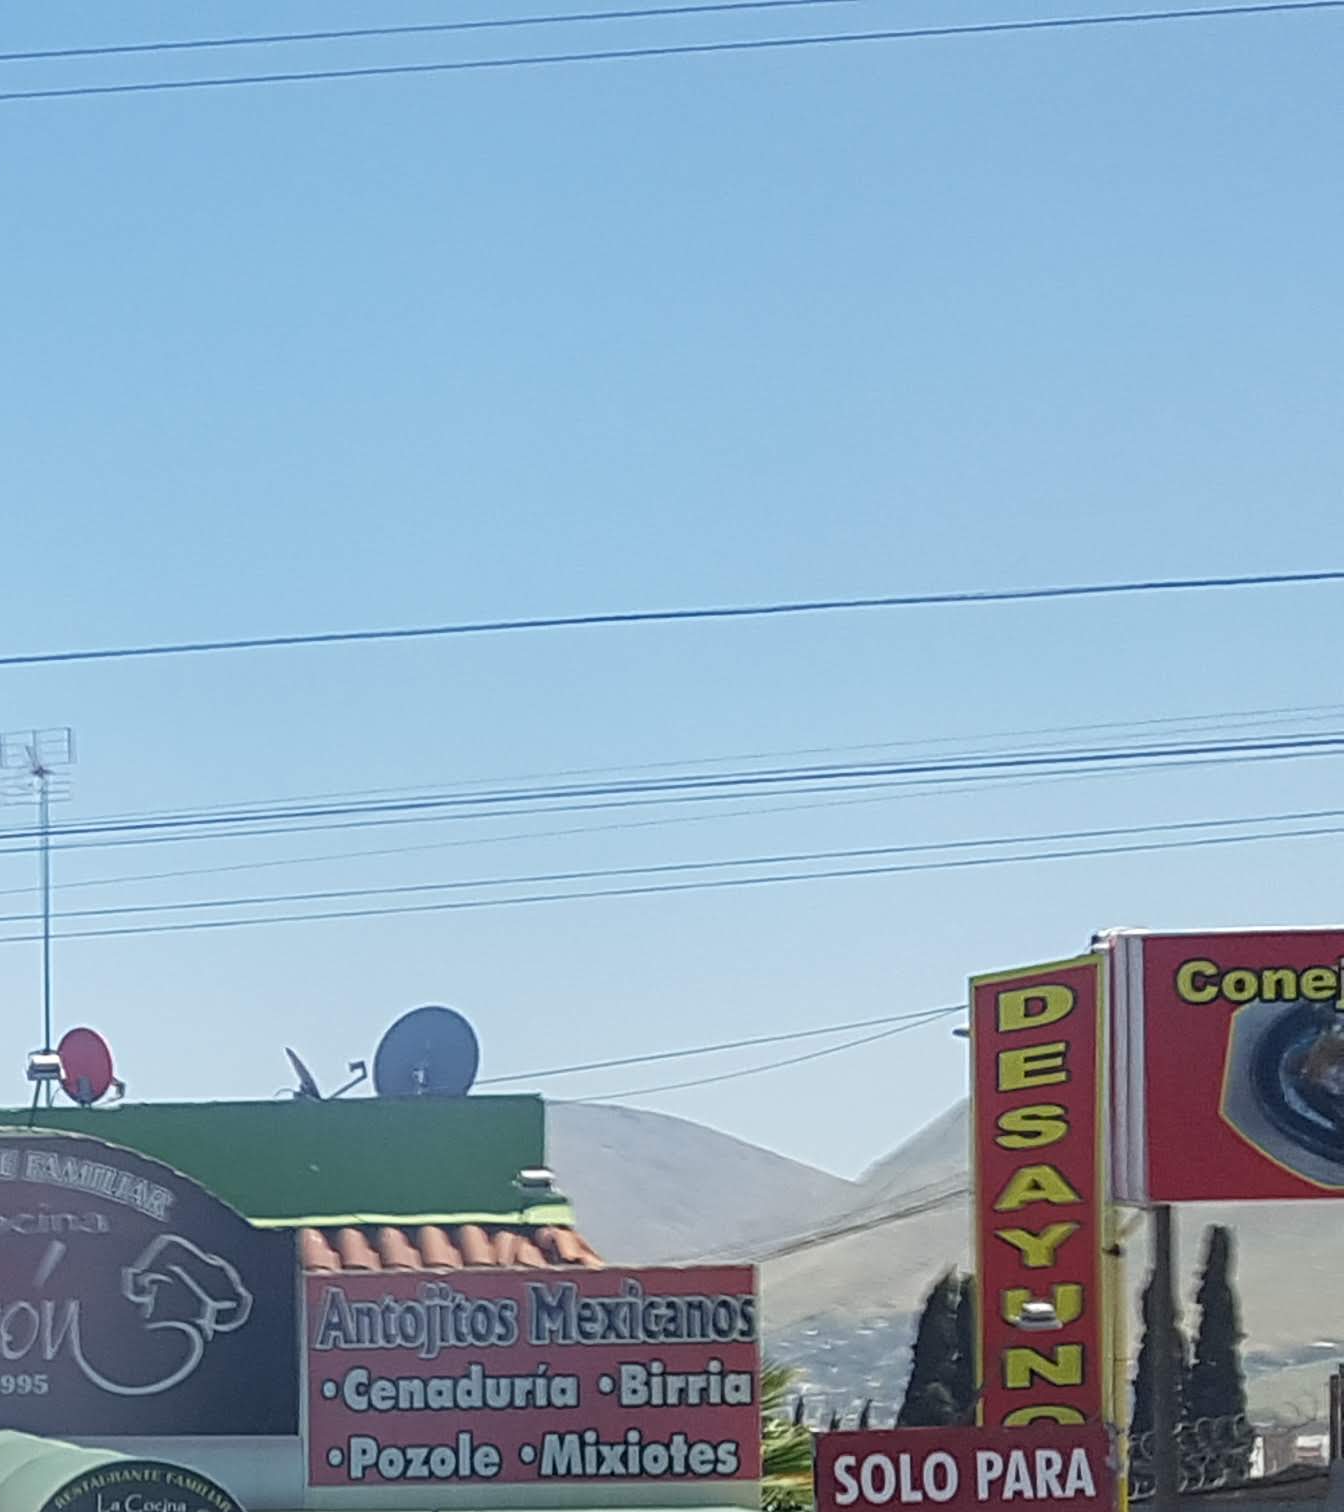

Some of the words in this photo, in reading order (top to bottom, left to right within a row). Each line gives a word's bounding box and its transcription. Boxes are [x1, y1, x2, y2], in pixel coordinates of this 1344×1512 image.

[25, 1150, 177, 1223] FAMILIAR
[313, 1280, 518, 1359] Antojitos
[527, 1278, 758, 1345] Mexicanos
[342, 1362, 580, 1411] Cenaduría
[619, 1359, 753, 1407] Birria
[348, 1430, 502, 1481] Pozole
[539, 1429, 740, 1477] Mixiotes
[833, 1451, 959, 1505] SOLO
[975, 1447, 1097, 1500] PARA
